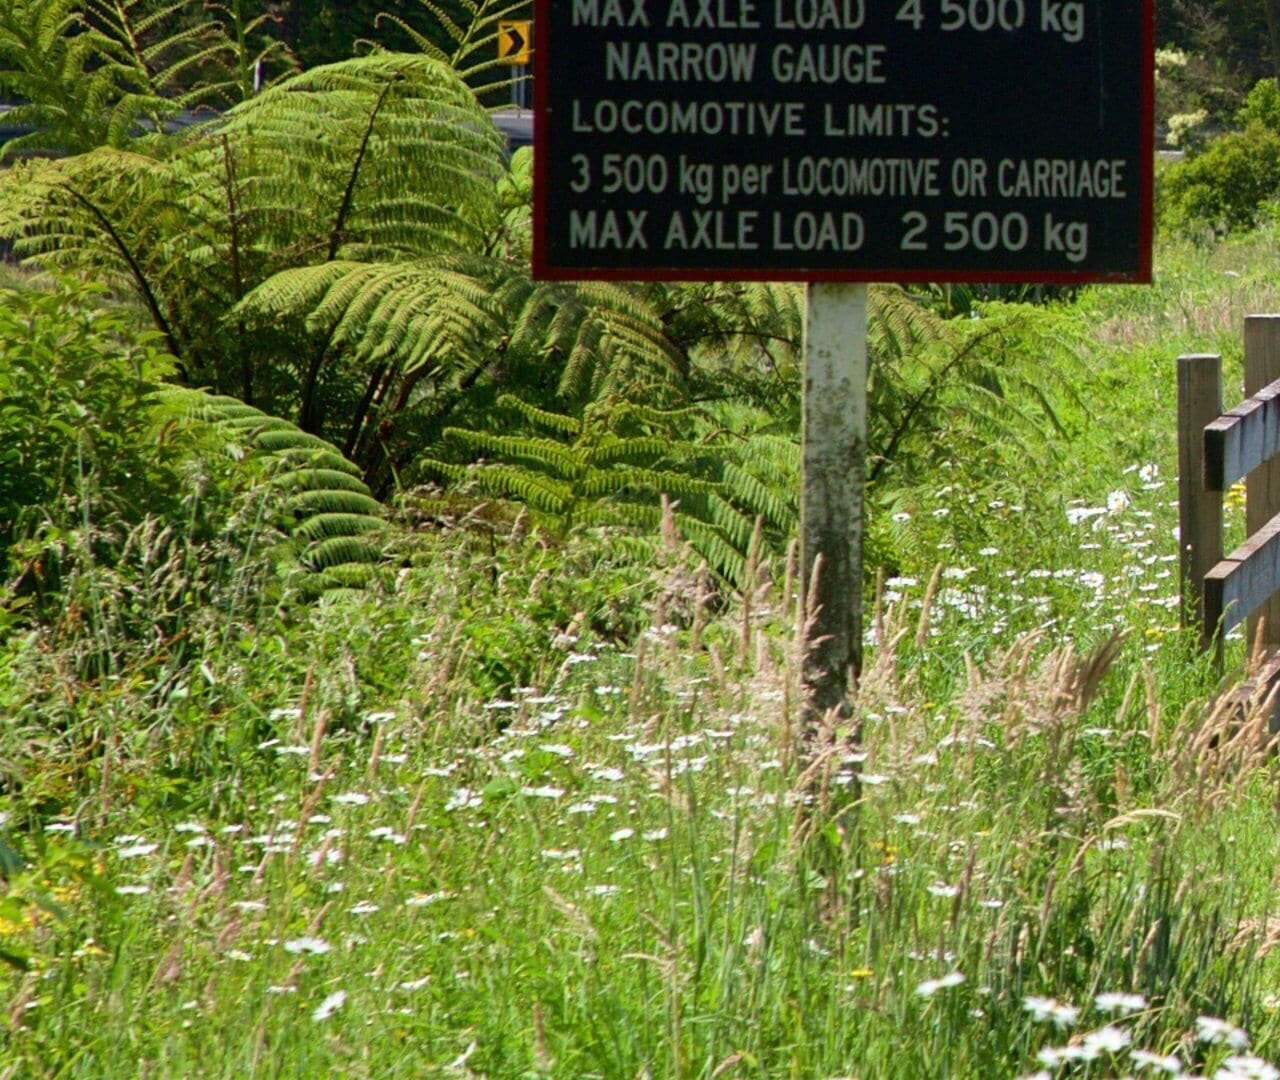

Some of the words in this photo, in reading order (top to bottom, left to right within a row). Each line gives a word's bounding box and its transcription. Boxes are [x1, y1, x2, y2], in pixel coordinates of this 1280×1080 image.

[606, 41, 757, 82] NARROW
[771, 43, 887, 84] GAUGE
[572, 99, 805, 136] LOCOMOTIVE
[824, 103, 949, 138] LIMITS:
[570, 153, 591, 193] 3
[602, 153, 668, 194] 500
[679, 154, 714, 205] kg
[722, 163, 773, 205] per
[782, 155, 941, 197] LOCOMOTIVE
[951, 157, 988, 198] OR
[997, 157, 1127, 199] CARRIAGE
[569, 209, 648, 249] MAX
[663, 209, 759, 250] AXLE
[772, 211, 865, 251] LOAD
[900, 210, 928, 251] 2
[943, 211, 1029, 252] 500
[1043, 212, 1089, 264] kg
